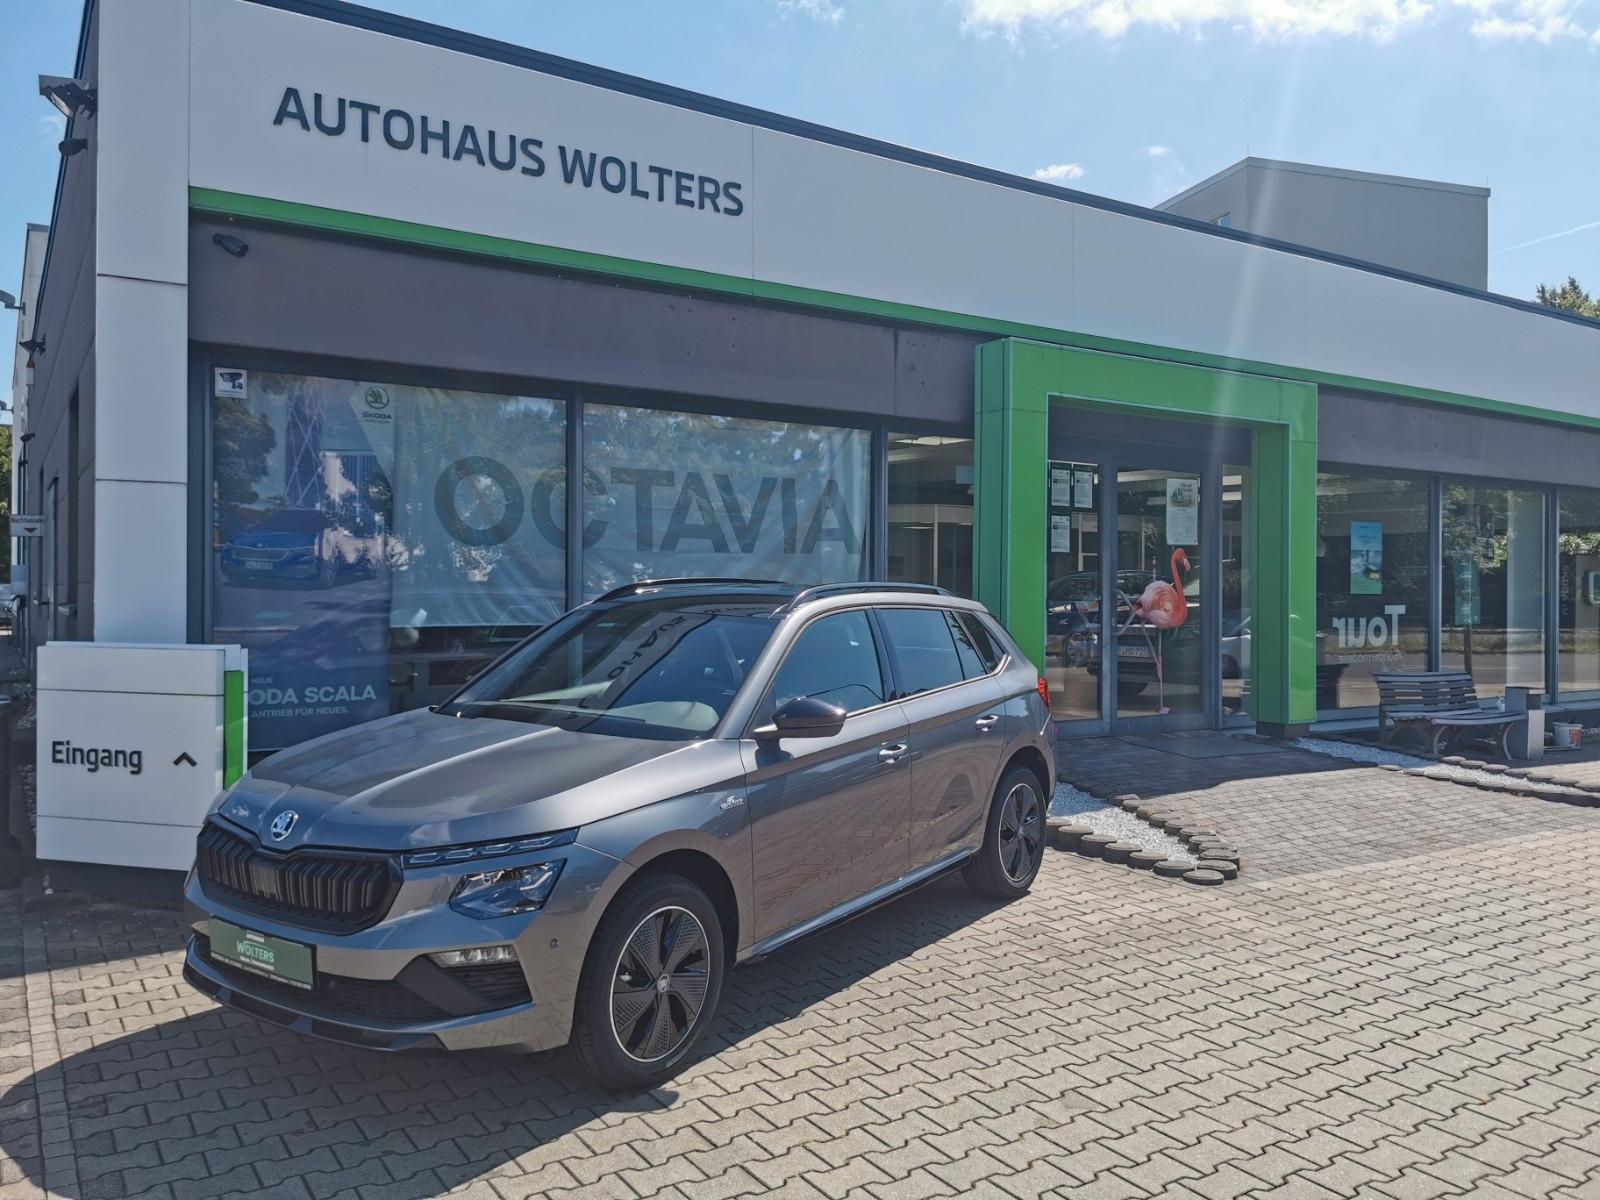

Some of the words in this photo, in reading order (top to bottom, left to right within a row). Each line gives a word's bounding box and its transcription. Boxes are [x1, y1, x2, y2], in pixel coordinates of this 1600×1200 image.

[272, 86, 546, 178] AUTOHAUS
[557, 145, 744, 217] WOLTERS
[434, 455, 861, 555] OCTAVIA
[304, 684, 377, 703] SCALA
[251, 708, 294, 719] ANTRIEB
[295, 705, 314, 716] FÜR
[51, 740, 143, 775] Eingang
[236, 940, 275, 963] WOLTERS
